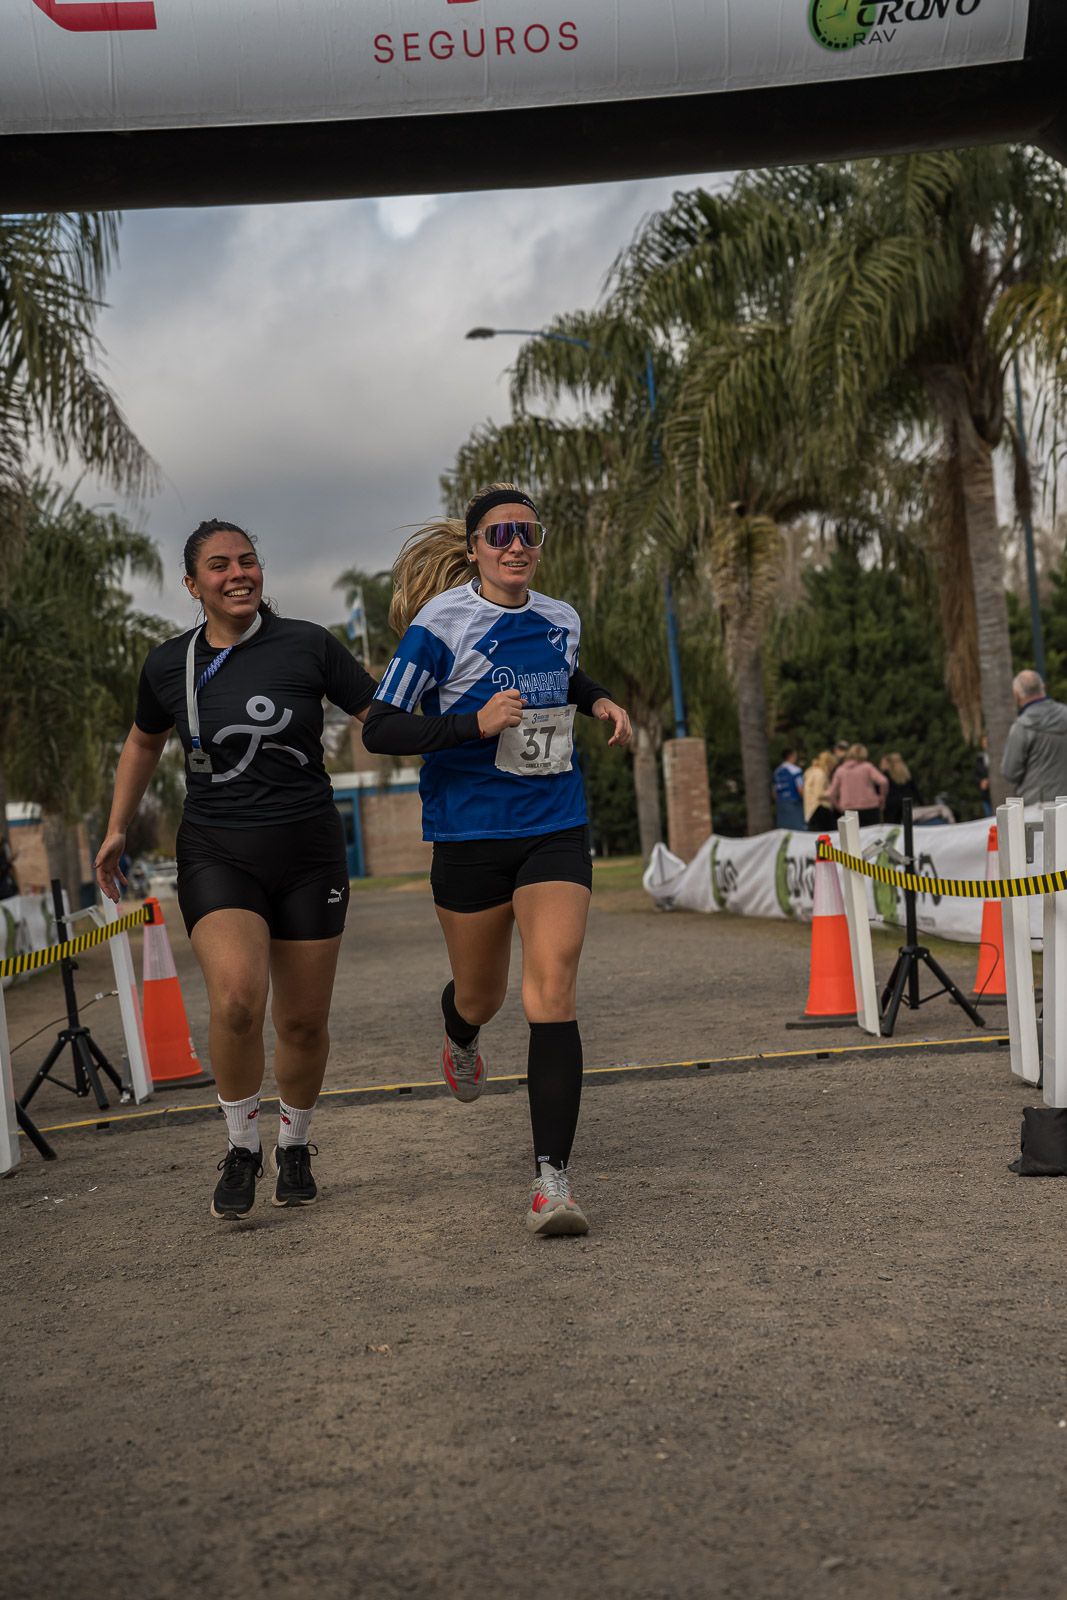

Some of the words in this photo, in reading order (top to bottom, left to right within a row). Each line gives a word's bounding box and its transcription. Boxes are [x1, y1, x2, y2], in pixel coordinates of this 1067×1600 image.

[374, 21, 579, 63] SEGUROS
[853, 29, 897, 46] RAV
[520, 726, 557, 761] 37
